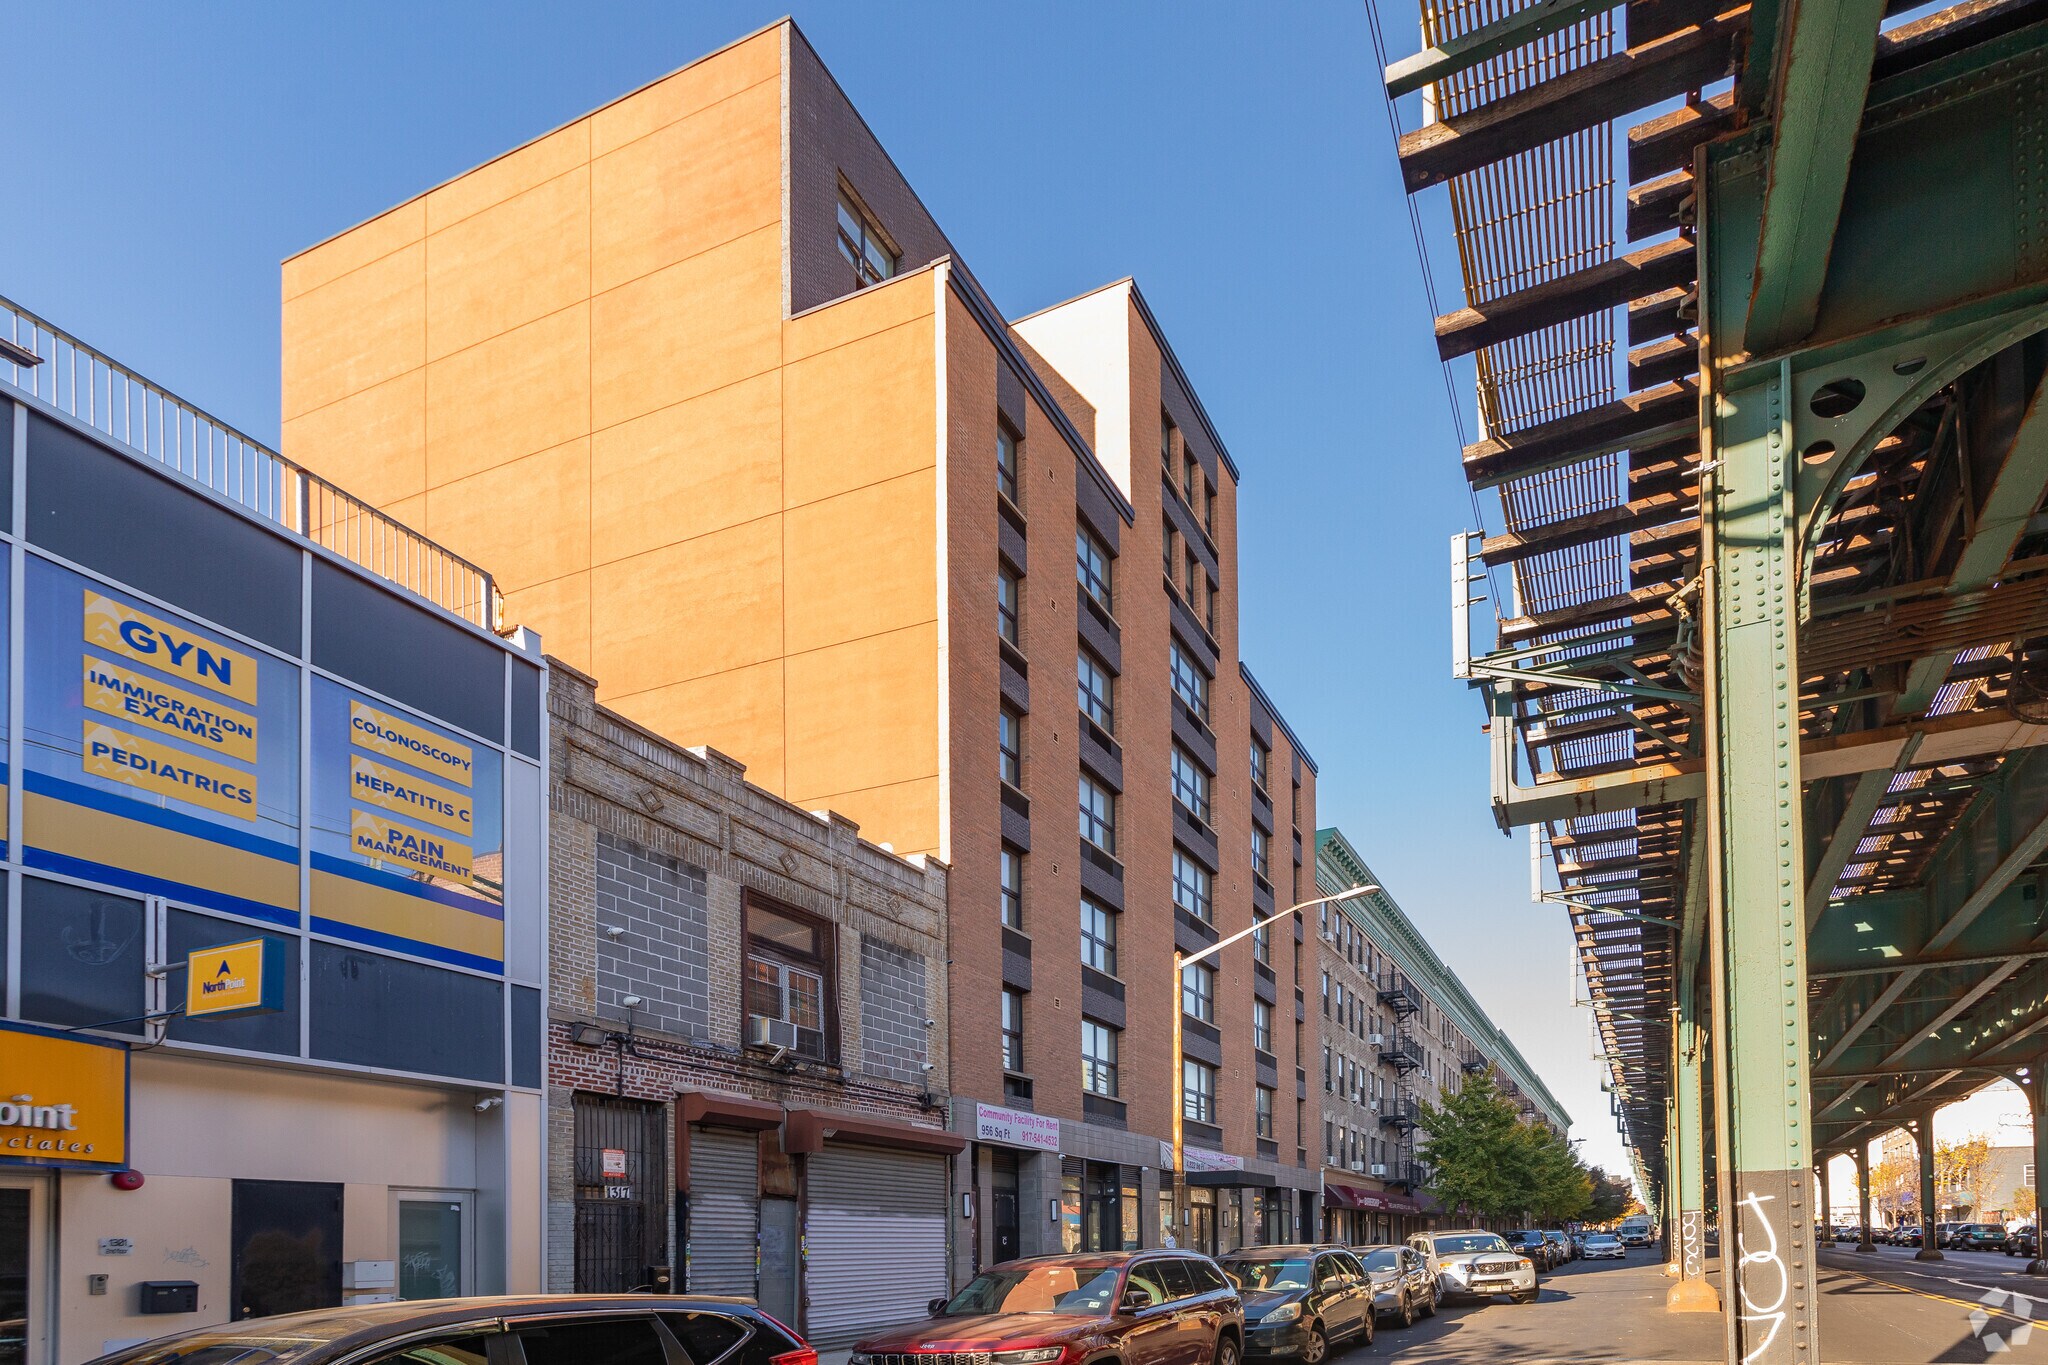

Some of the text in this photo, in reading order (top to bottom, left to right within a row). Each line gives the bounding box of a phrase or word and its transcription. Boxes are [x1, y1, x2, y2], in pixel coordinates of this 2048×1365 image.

[119, 620, 231, 686] GYN
[90, 670, 253, 739] IMMIGRATION
[125, 696, 223, 743] EXAMS
[352, 717, 471, 771] COLONOSCOPY
[92, 741, 252, 804] PEDIATRICS
[355, 772, 470, 823] HEPATITIS C
[357, 835, 470, 878] MANAGEMENT
[388, 828, 444, 859] PAIN
[978, 1106, 1058, 1131] Community Facility For Rent
[981, 1124, 1011, 1140] 956 Sq Ft
[606, 1186, 630, 1199] 1317
